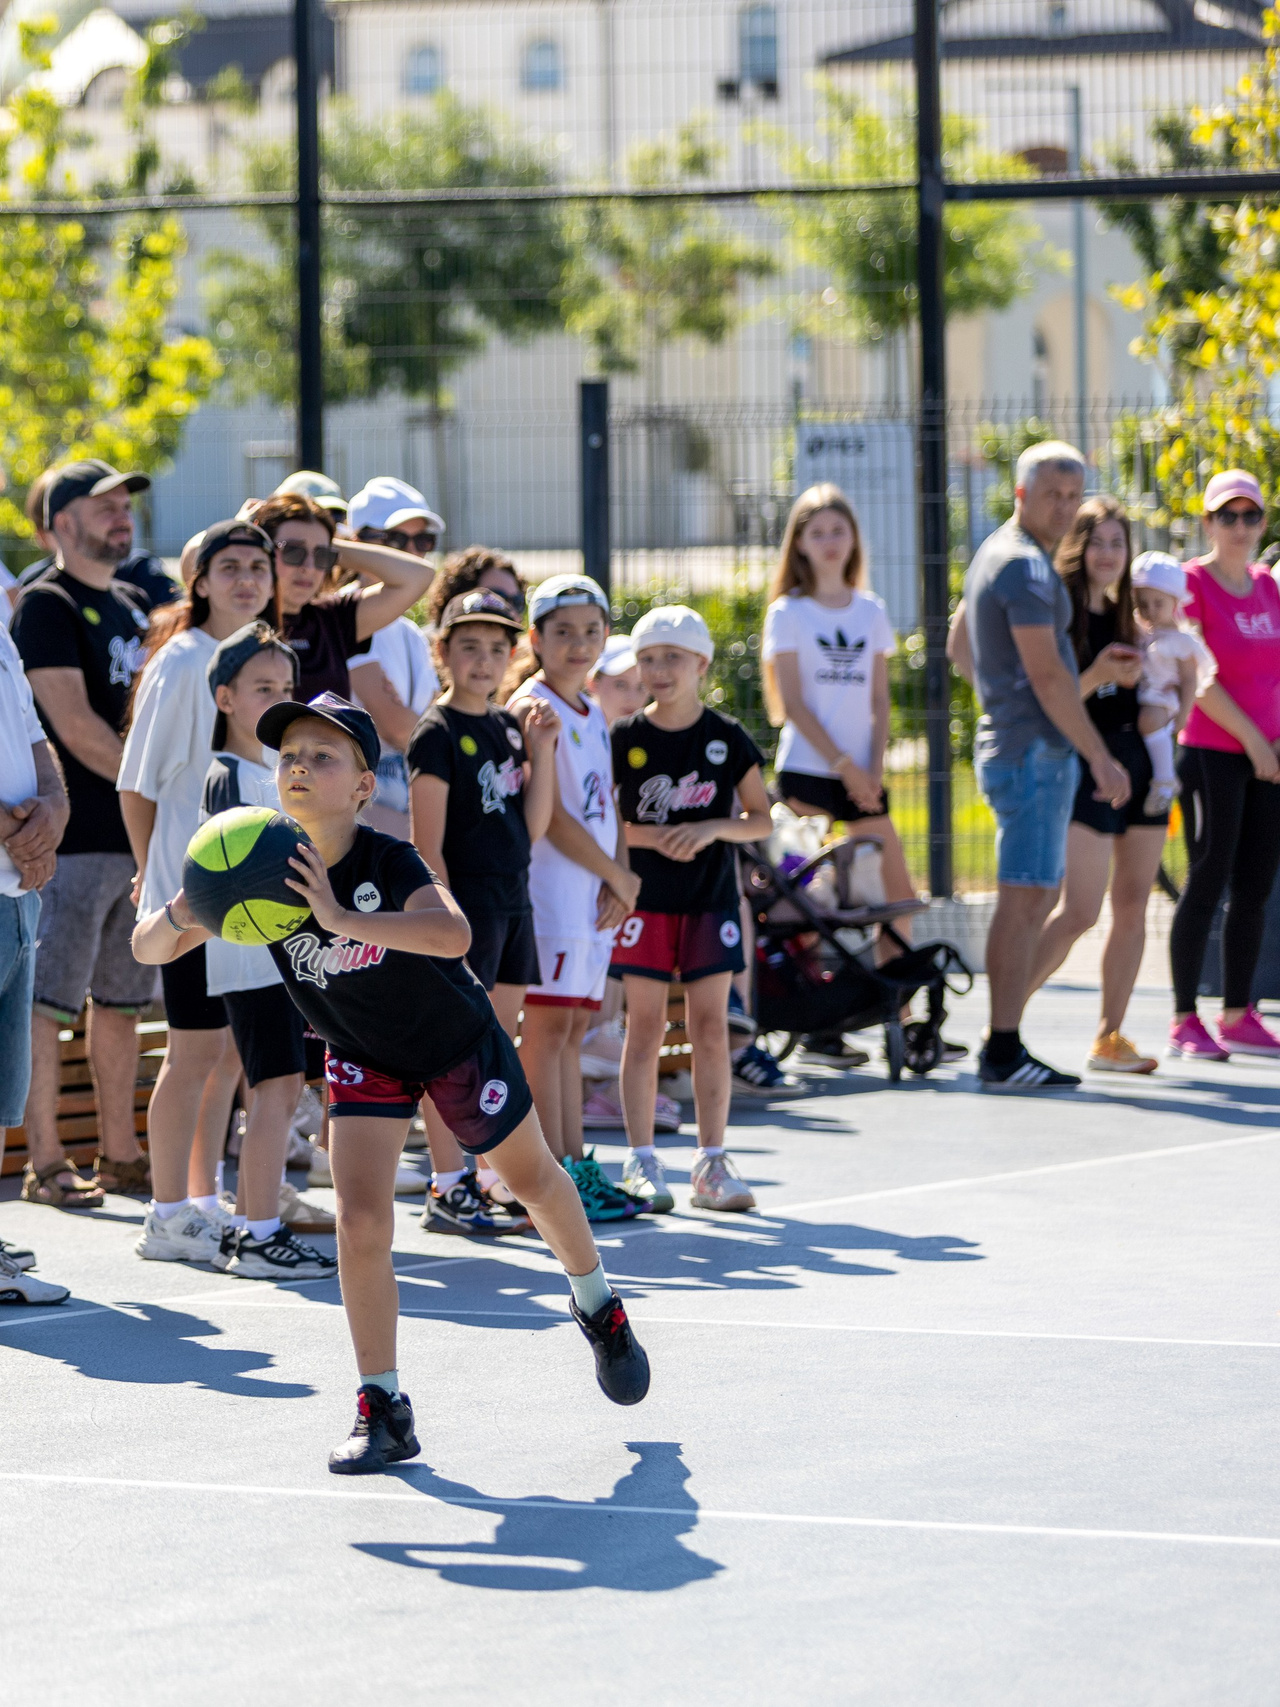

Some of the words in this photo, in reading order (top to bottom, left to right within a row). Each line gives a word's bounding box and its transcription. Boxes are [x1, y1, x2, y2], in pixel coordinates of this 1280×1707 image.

[357, 890, 378, 904] РФБ
[283, 932, 387, 989] Рубин
[552, 951, 567, 982] 1
